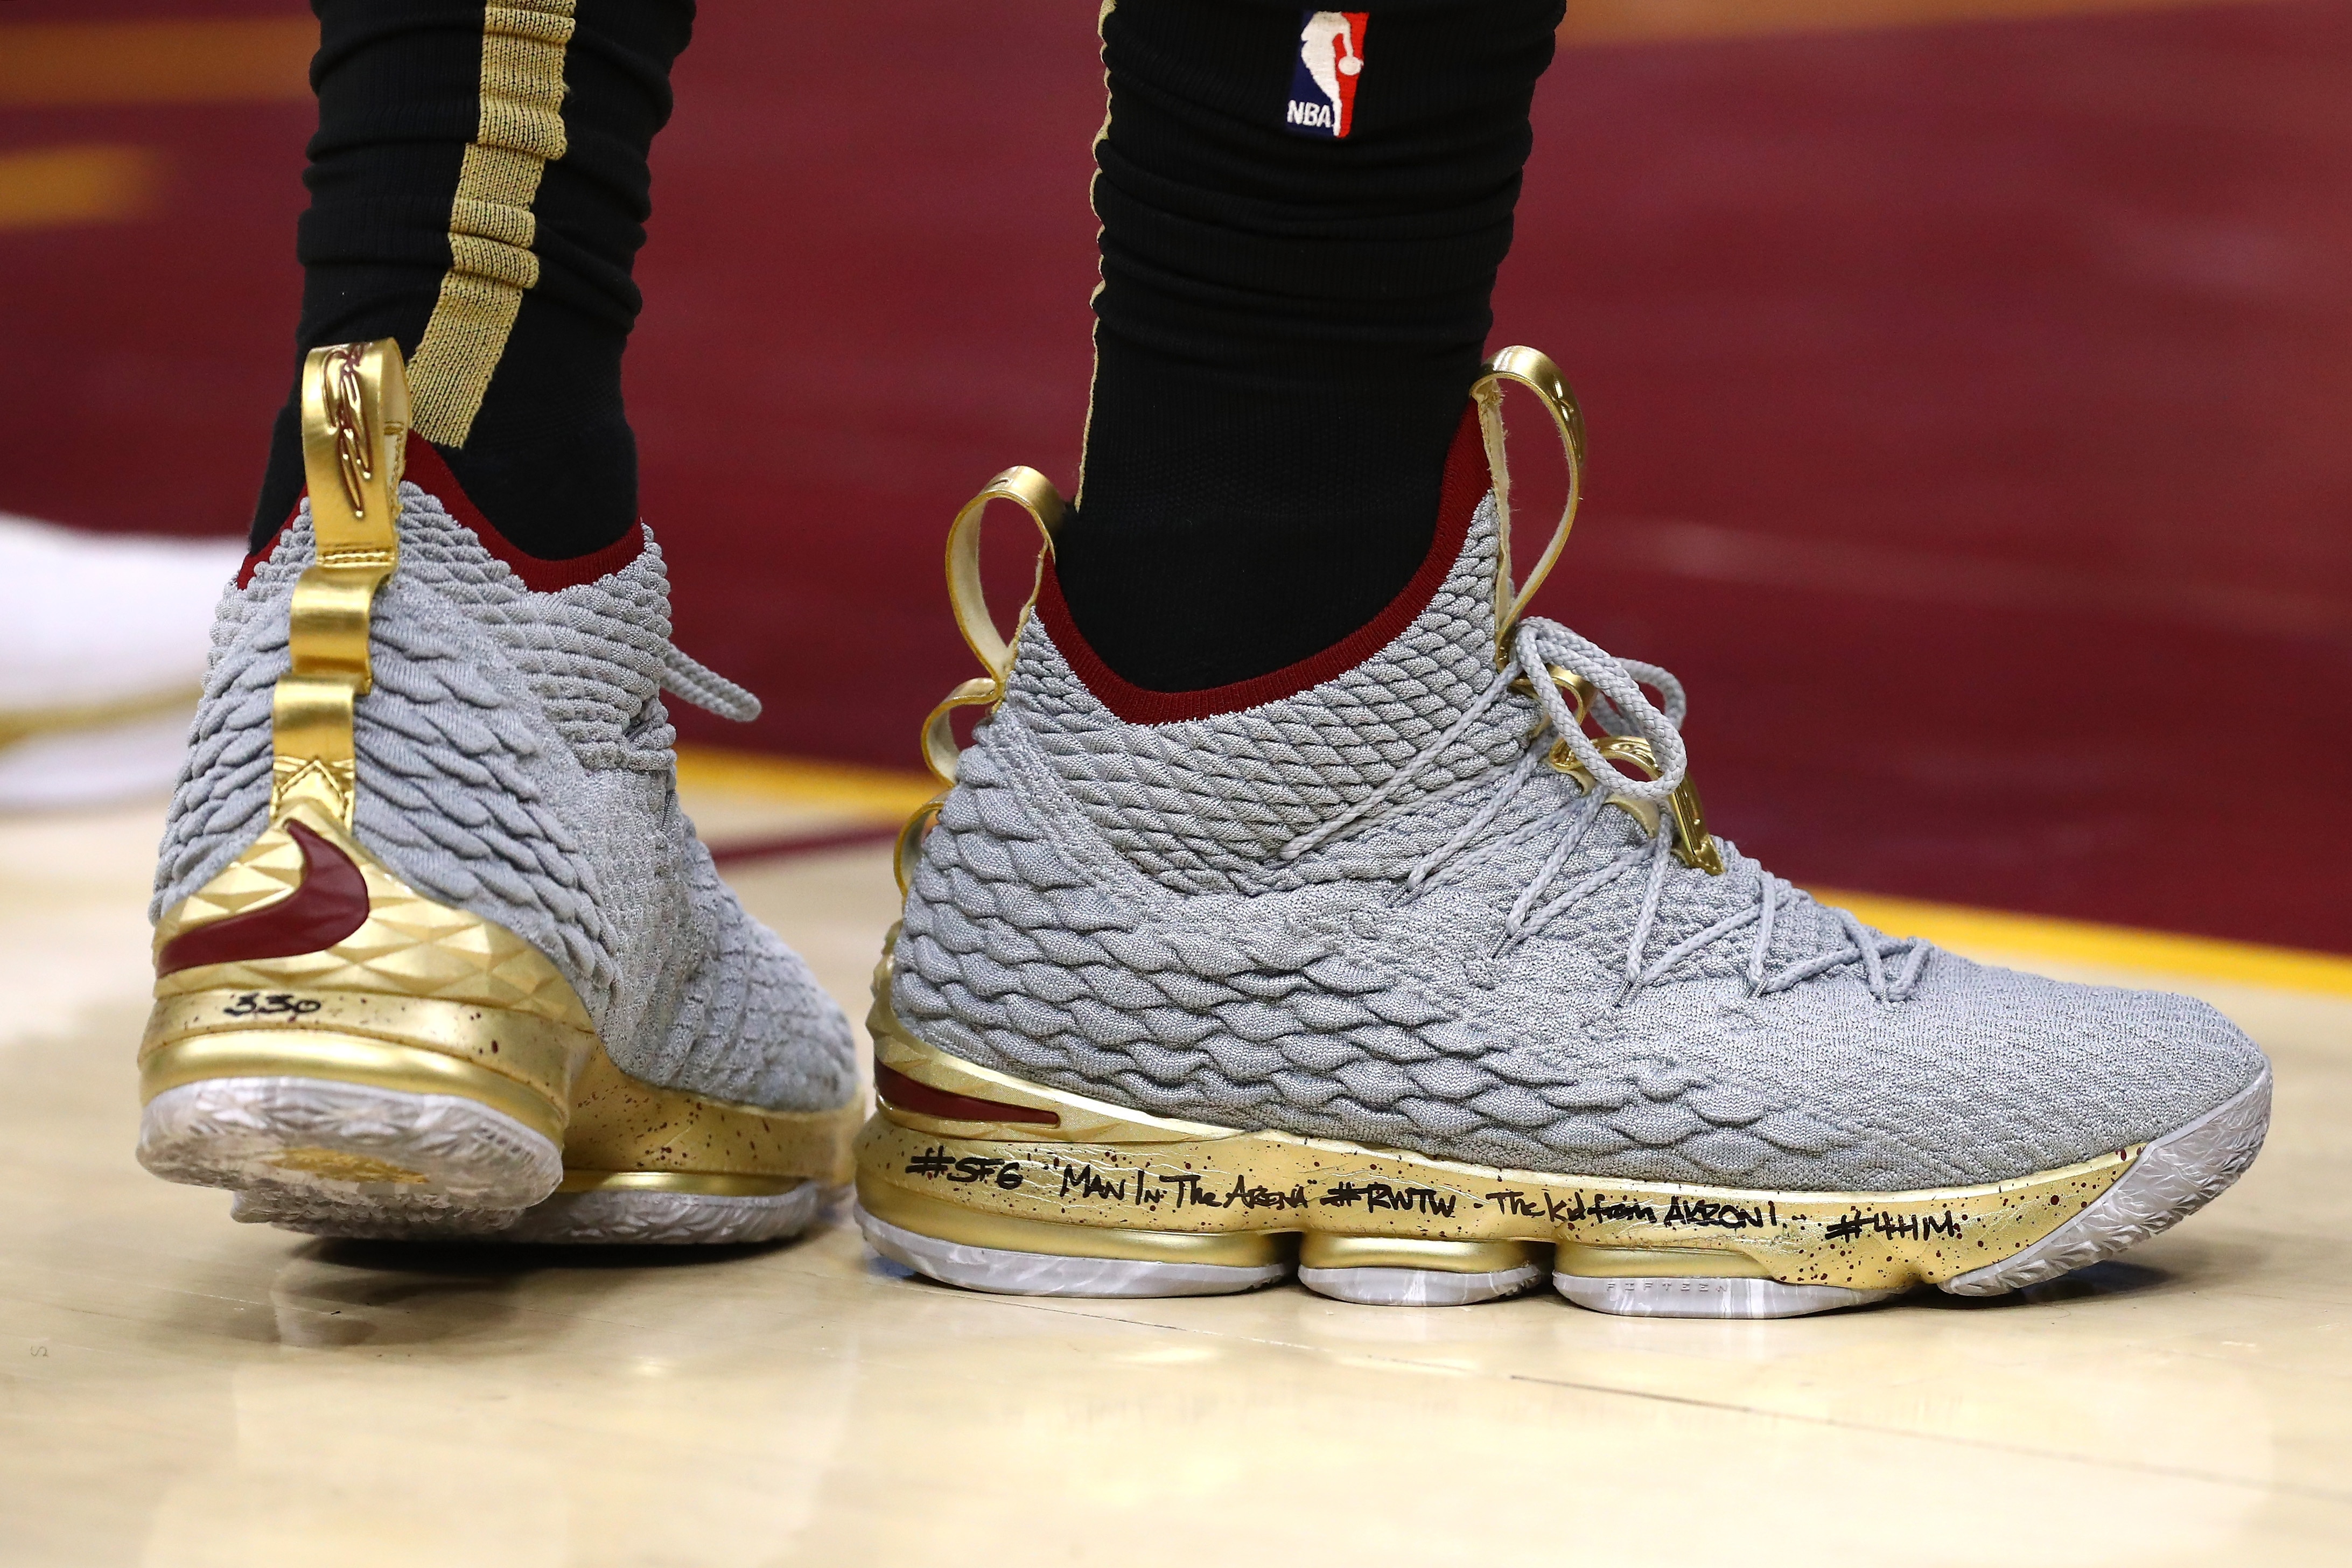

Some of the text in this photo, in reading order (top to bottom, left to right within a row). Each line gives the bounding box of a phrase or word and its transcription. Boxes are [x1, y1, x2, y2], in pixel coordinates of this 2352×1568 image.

[1287, 100, 1331, 128] NBA
[223, 992, 321, 1017] 330
[1607, 1282, 1727, 1292] FIFTEEN
